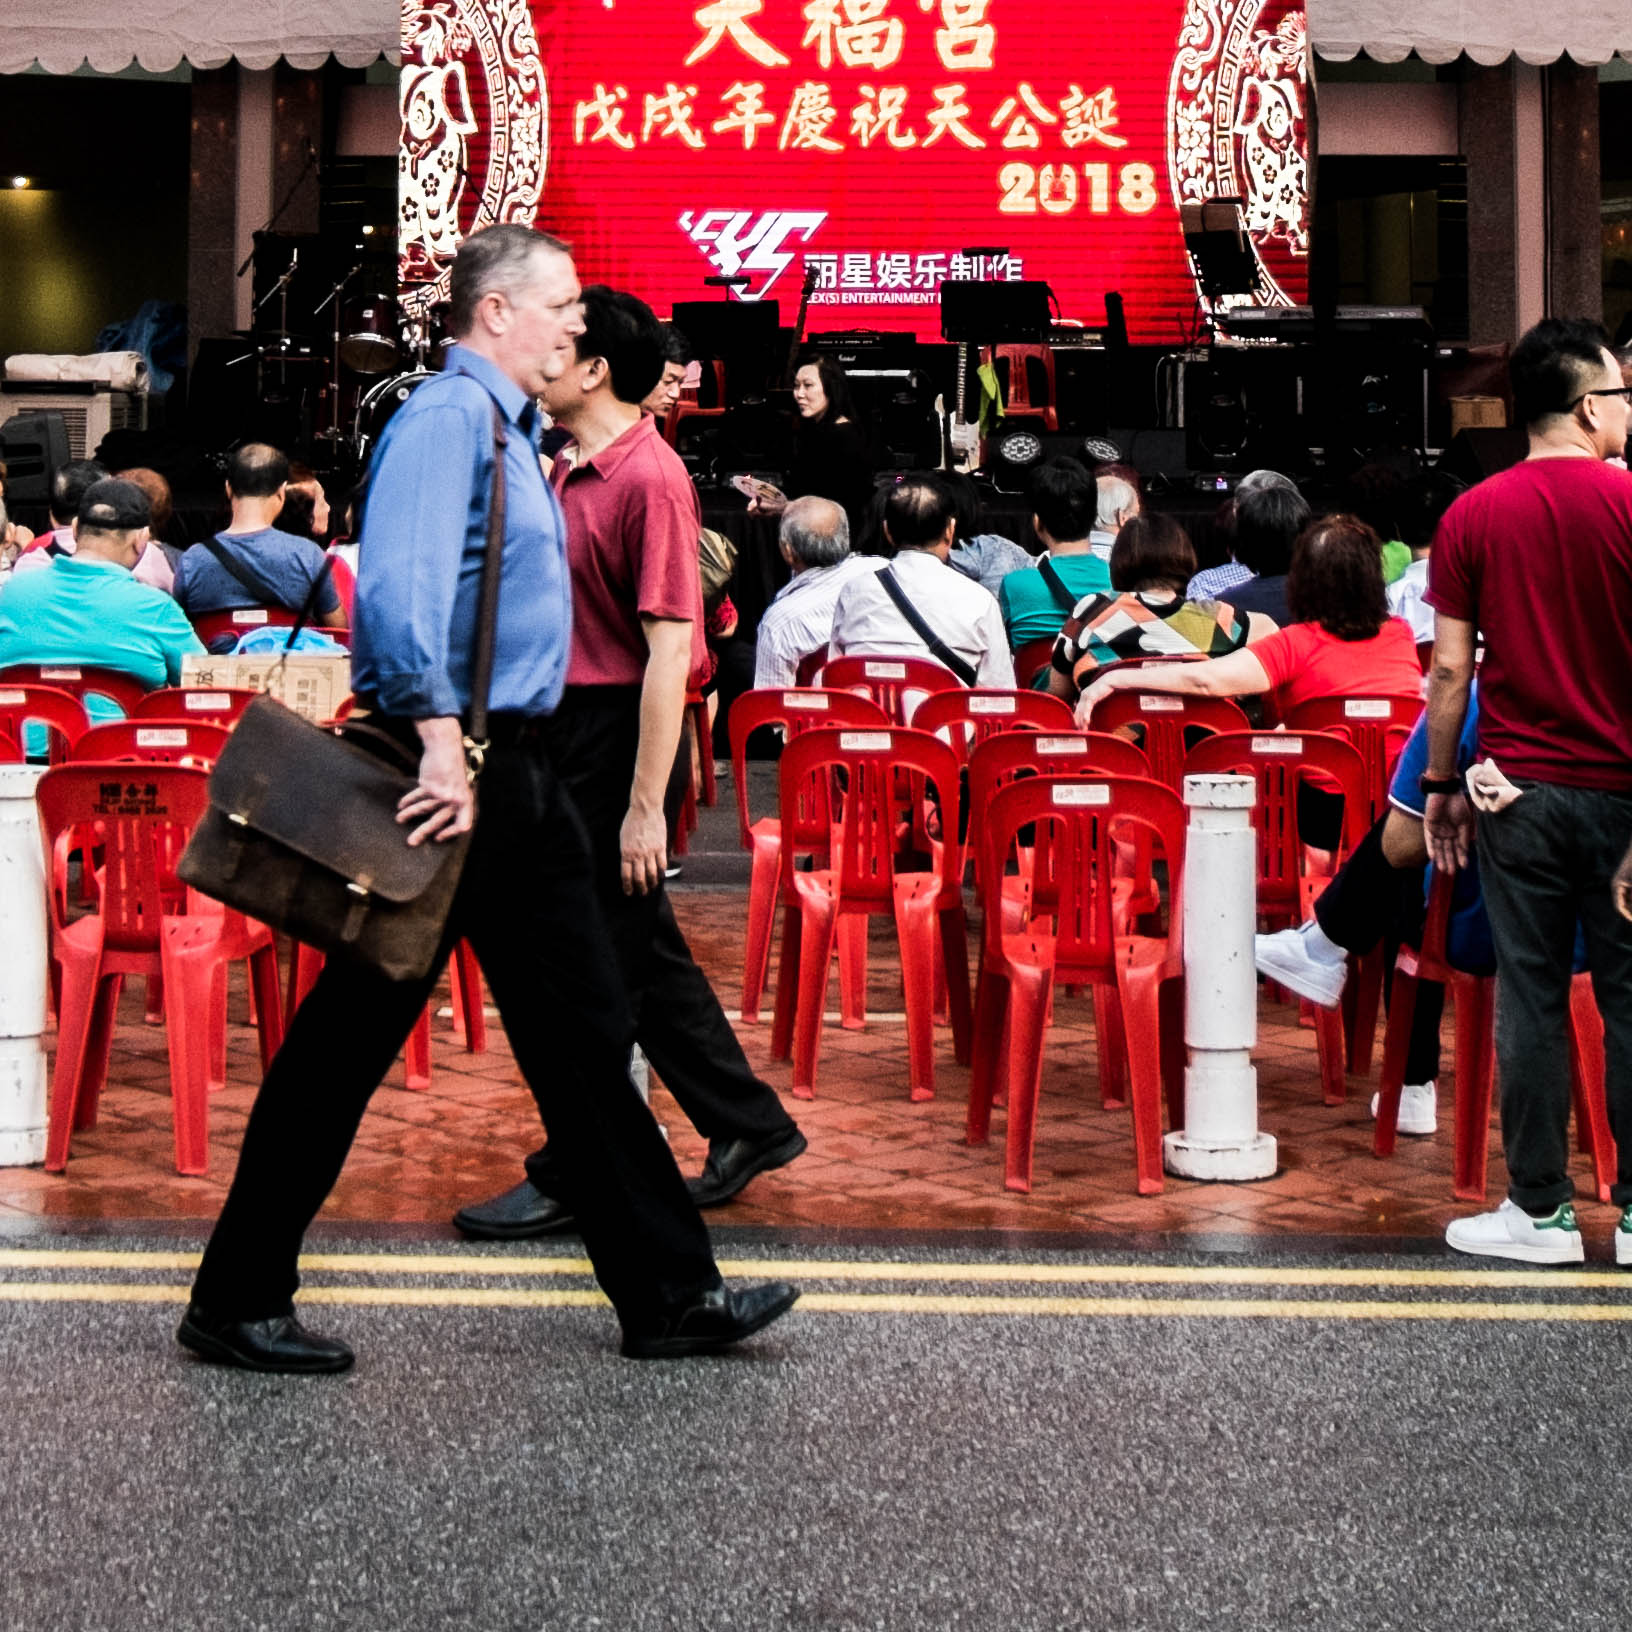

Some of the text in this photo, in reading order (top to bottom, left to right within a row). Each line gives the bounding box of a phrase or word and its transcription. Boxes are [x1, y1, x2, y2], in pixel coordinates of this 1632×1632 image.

[572, 82, 1129, 151] 戊戌年慶祝天公誕
[997, 162, 1158, 214] 2018
[841, 292, 936, 304] ENTERTAINMENT
